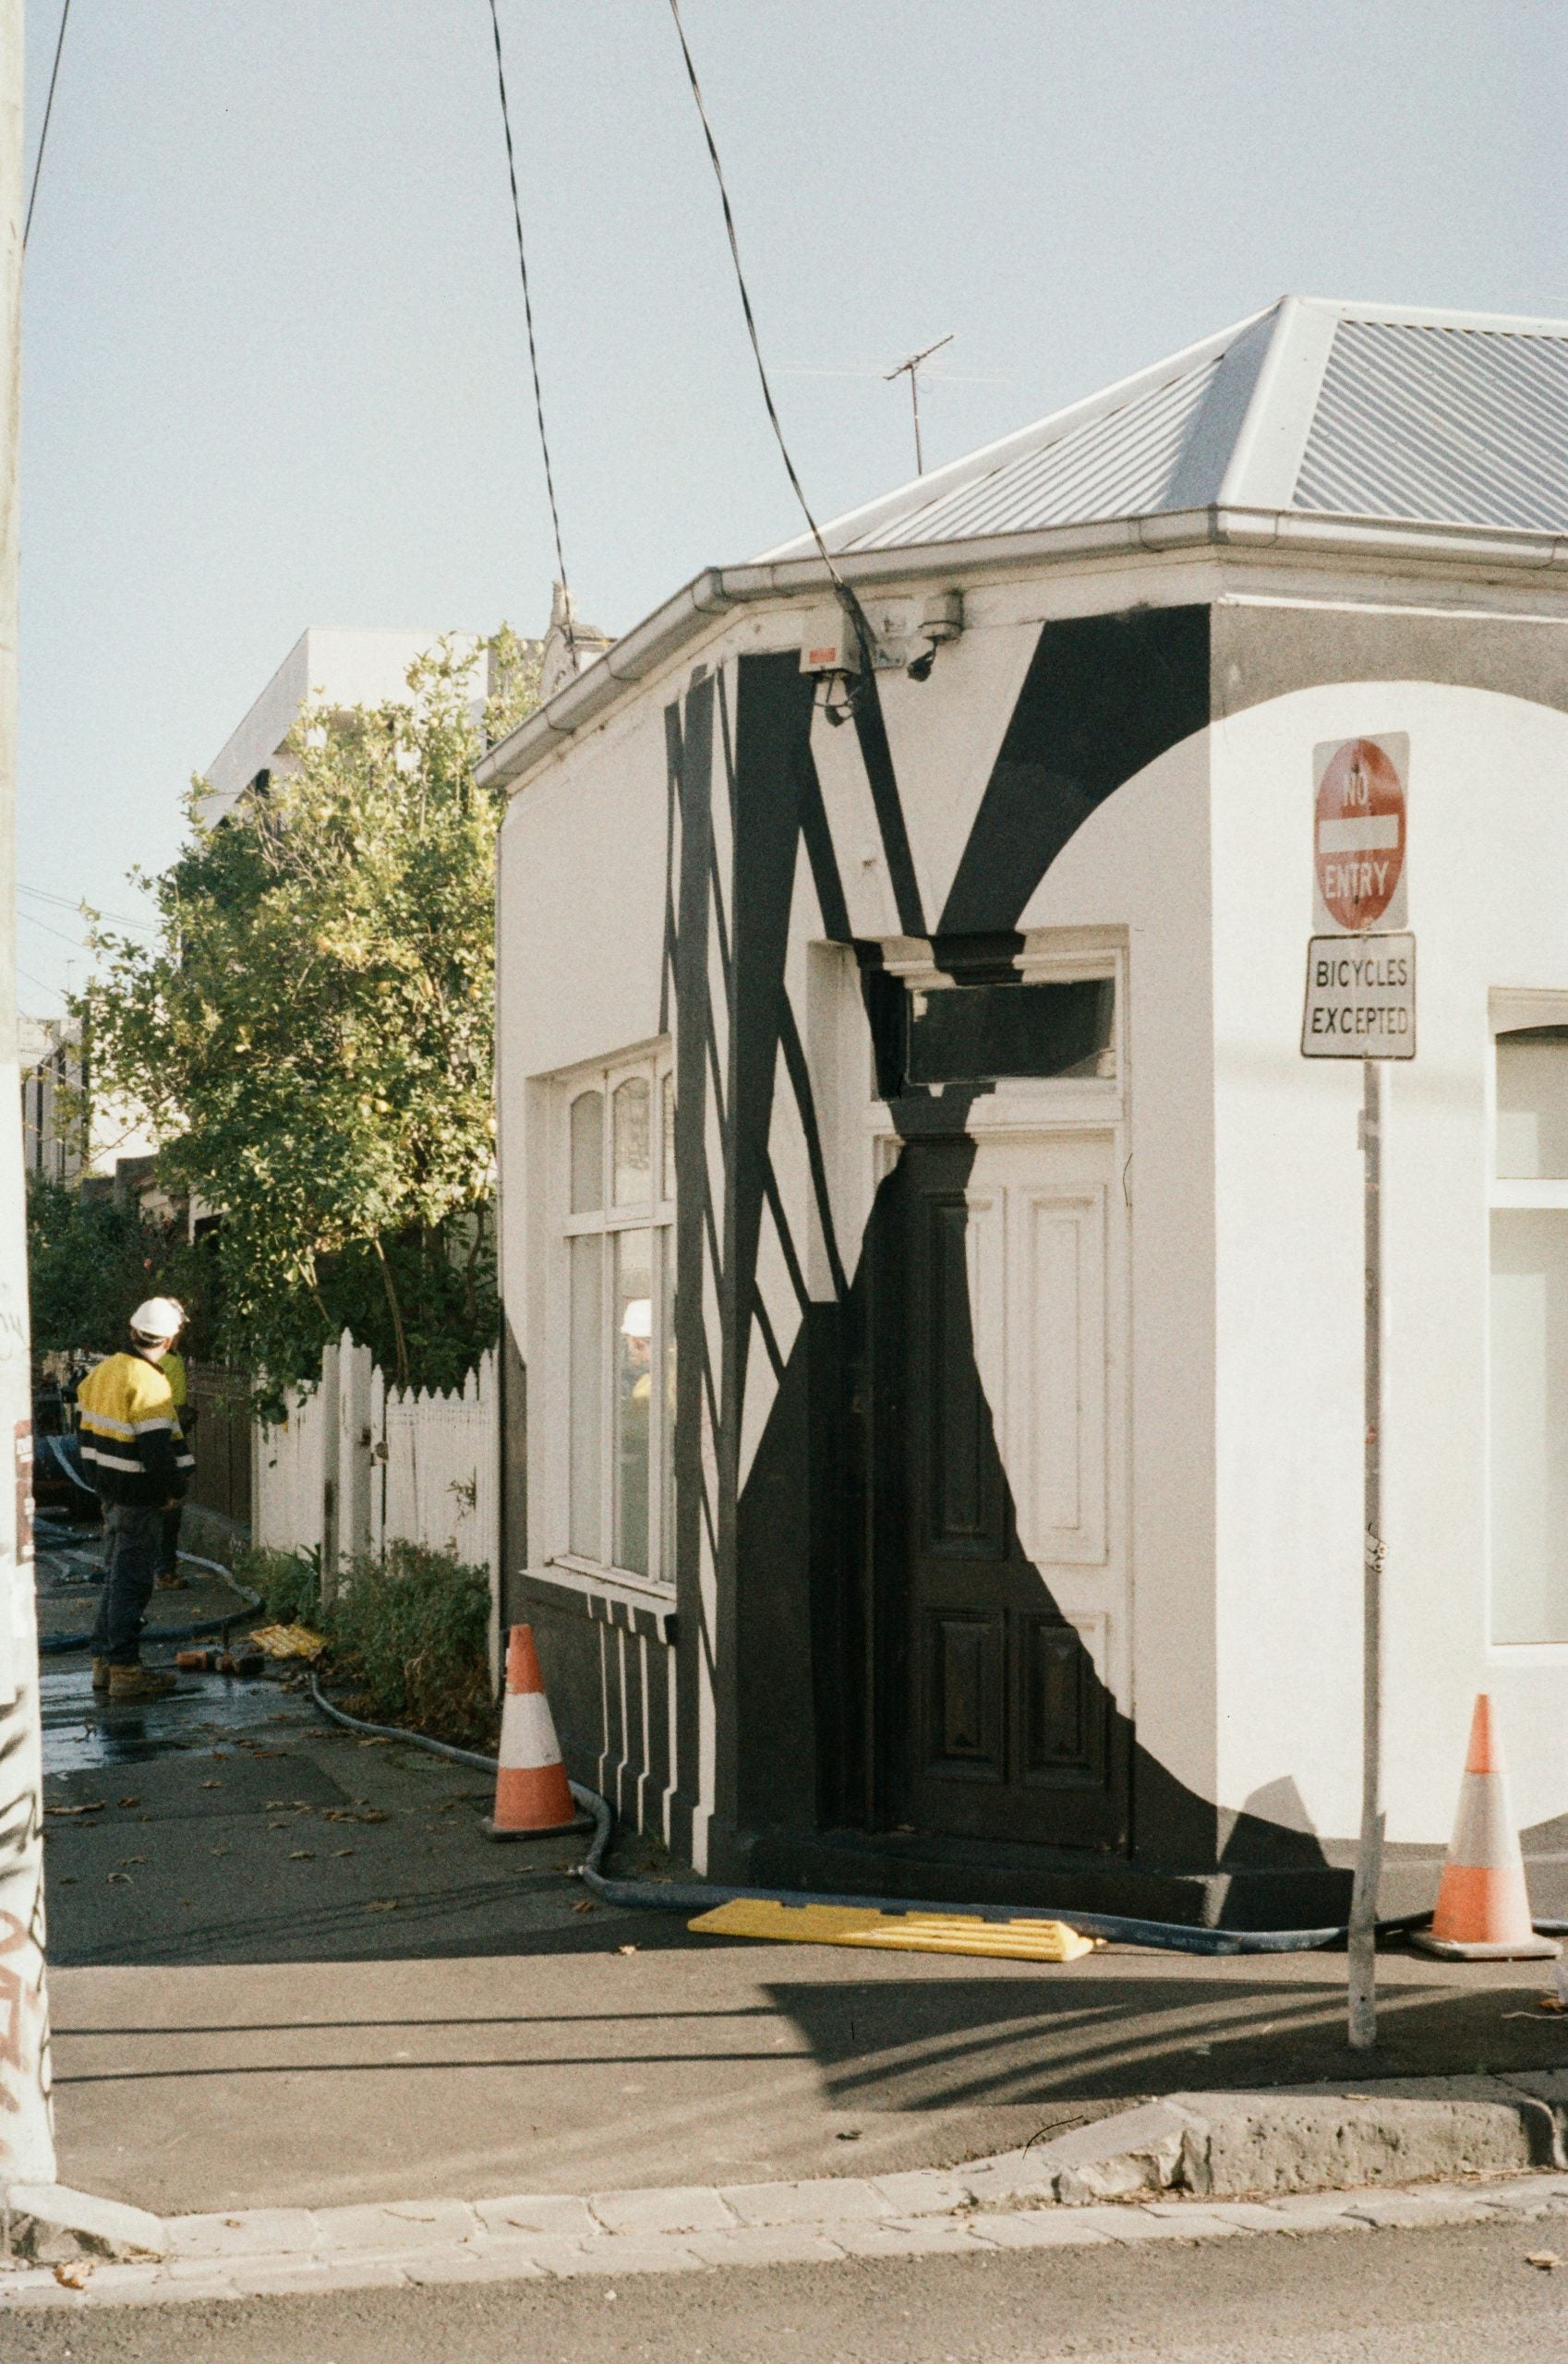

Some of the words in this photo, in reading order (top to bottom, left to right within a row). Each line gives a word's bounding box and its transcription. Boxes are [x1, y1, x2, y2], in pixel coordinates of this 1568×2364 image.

[1343, 771, 1369, 806] NO
[1325, 862, 1389, 899] ENTRY
[1316, 959, 1407, 987] BICYCLES
[1311, 1007, 1407, 1034] EXCEPTED
